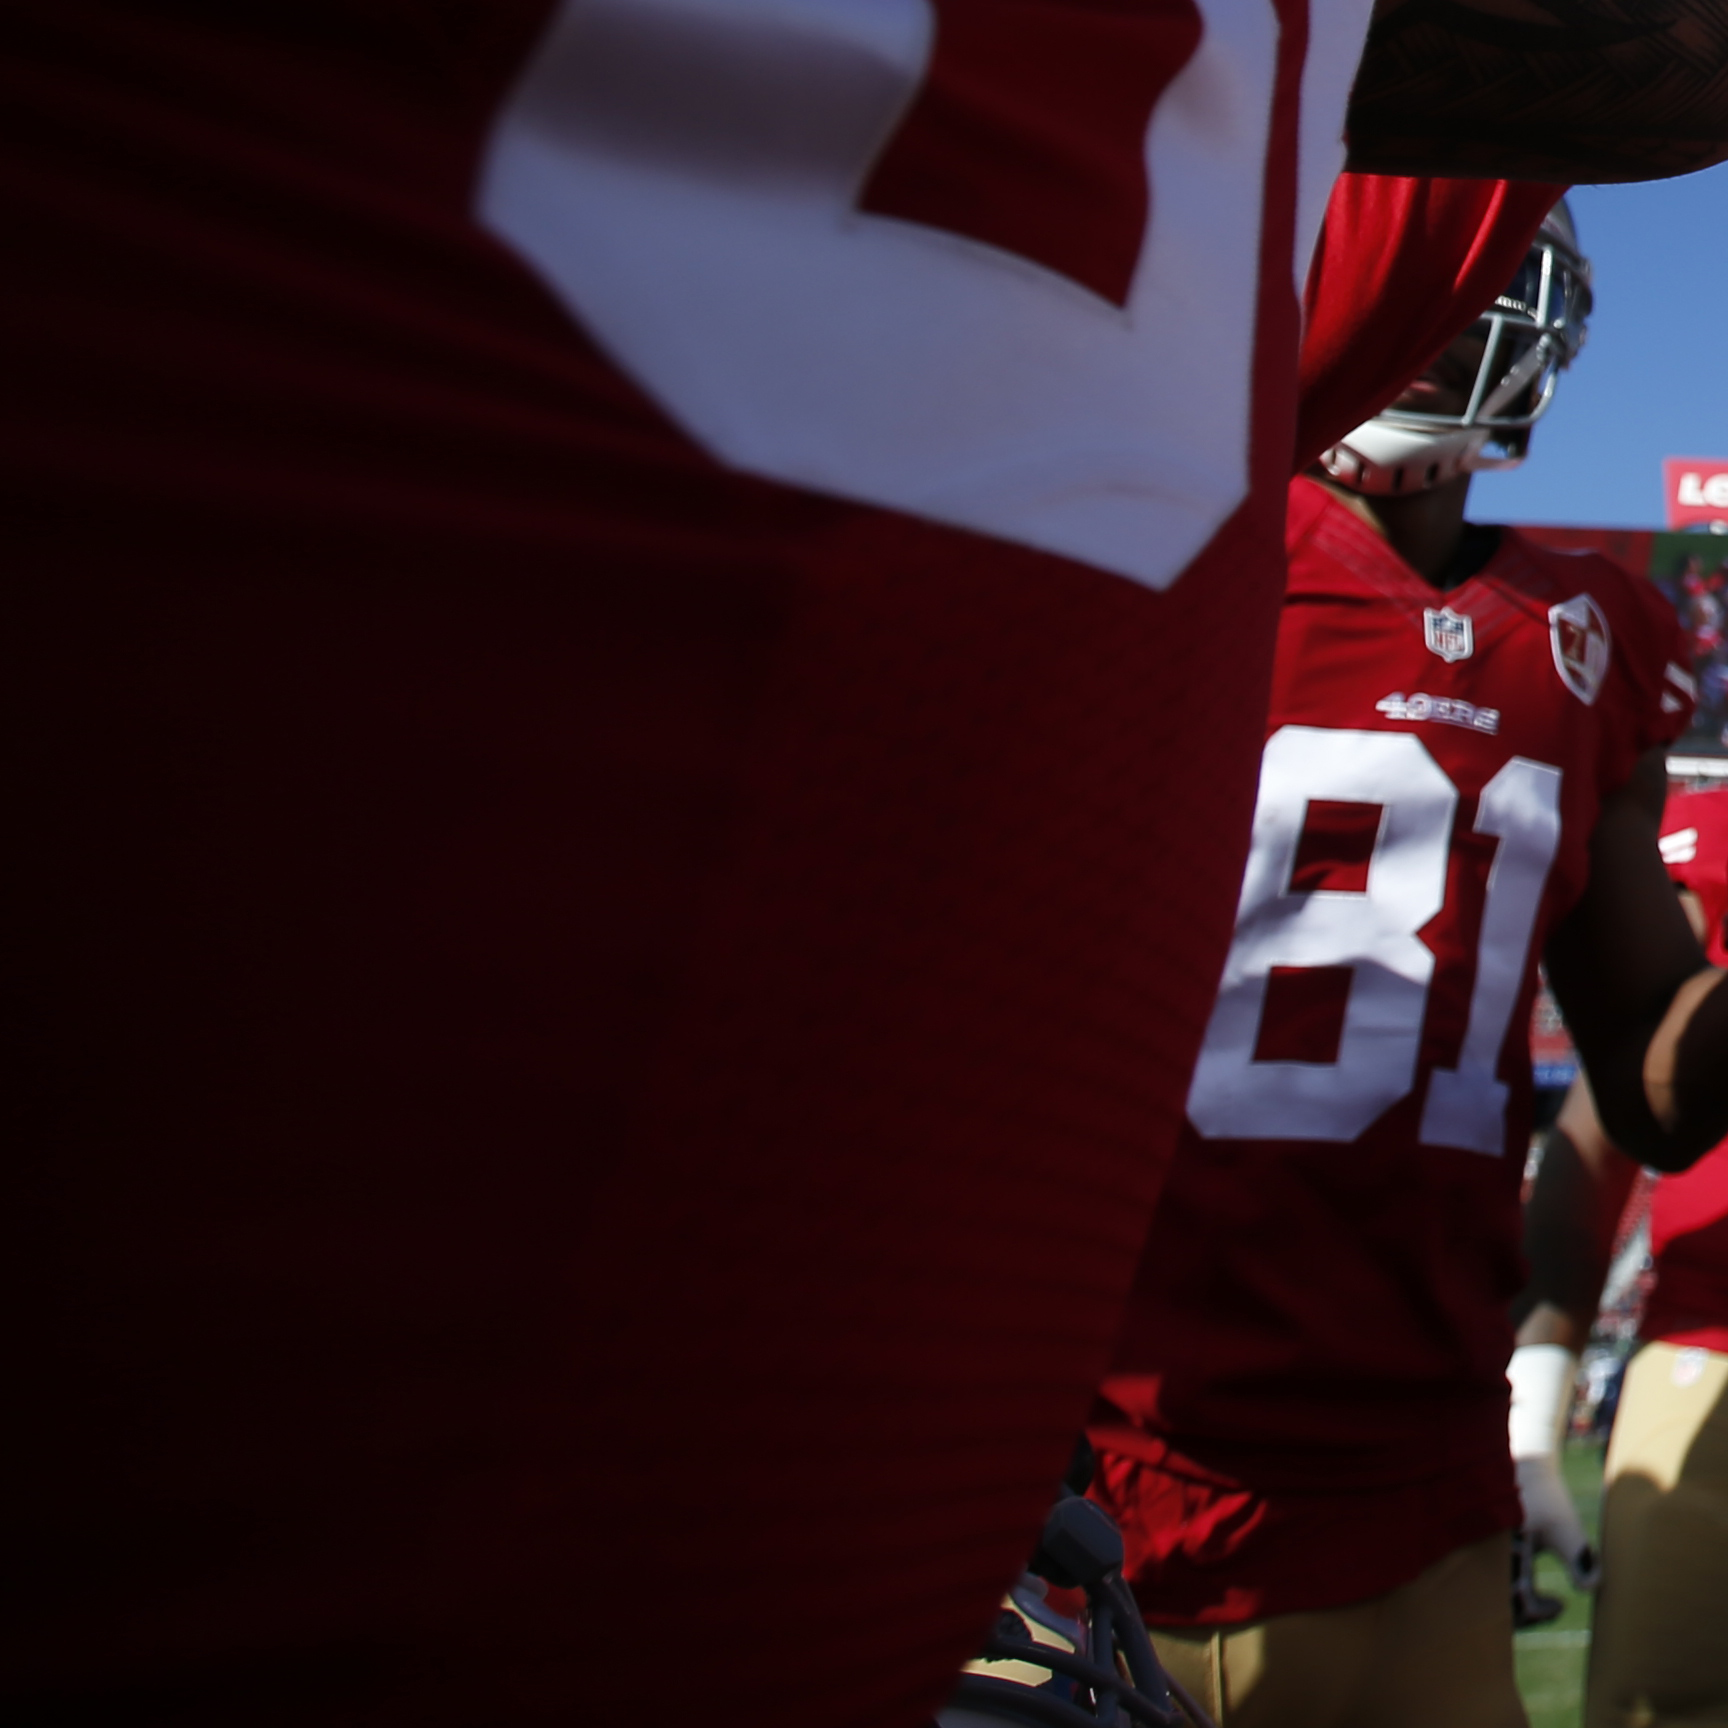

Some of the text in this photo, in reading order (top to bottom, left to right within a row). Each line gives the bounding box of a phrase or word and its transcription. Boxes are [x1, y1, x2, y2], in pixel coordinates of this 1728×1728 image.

[1434, 630, 1464, 652] NFL
[1375, 690, 1500, 736] 49ERS
[1185, 723, 1563, 1156] 81
